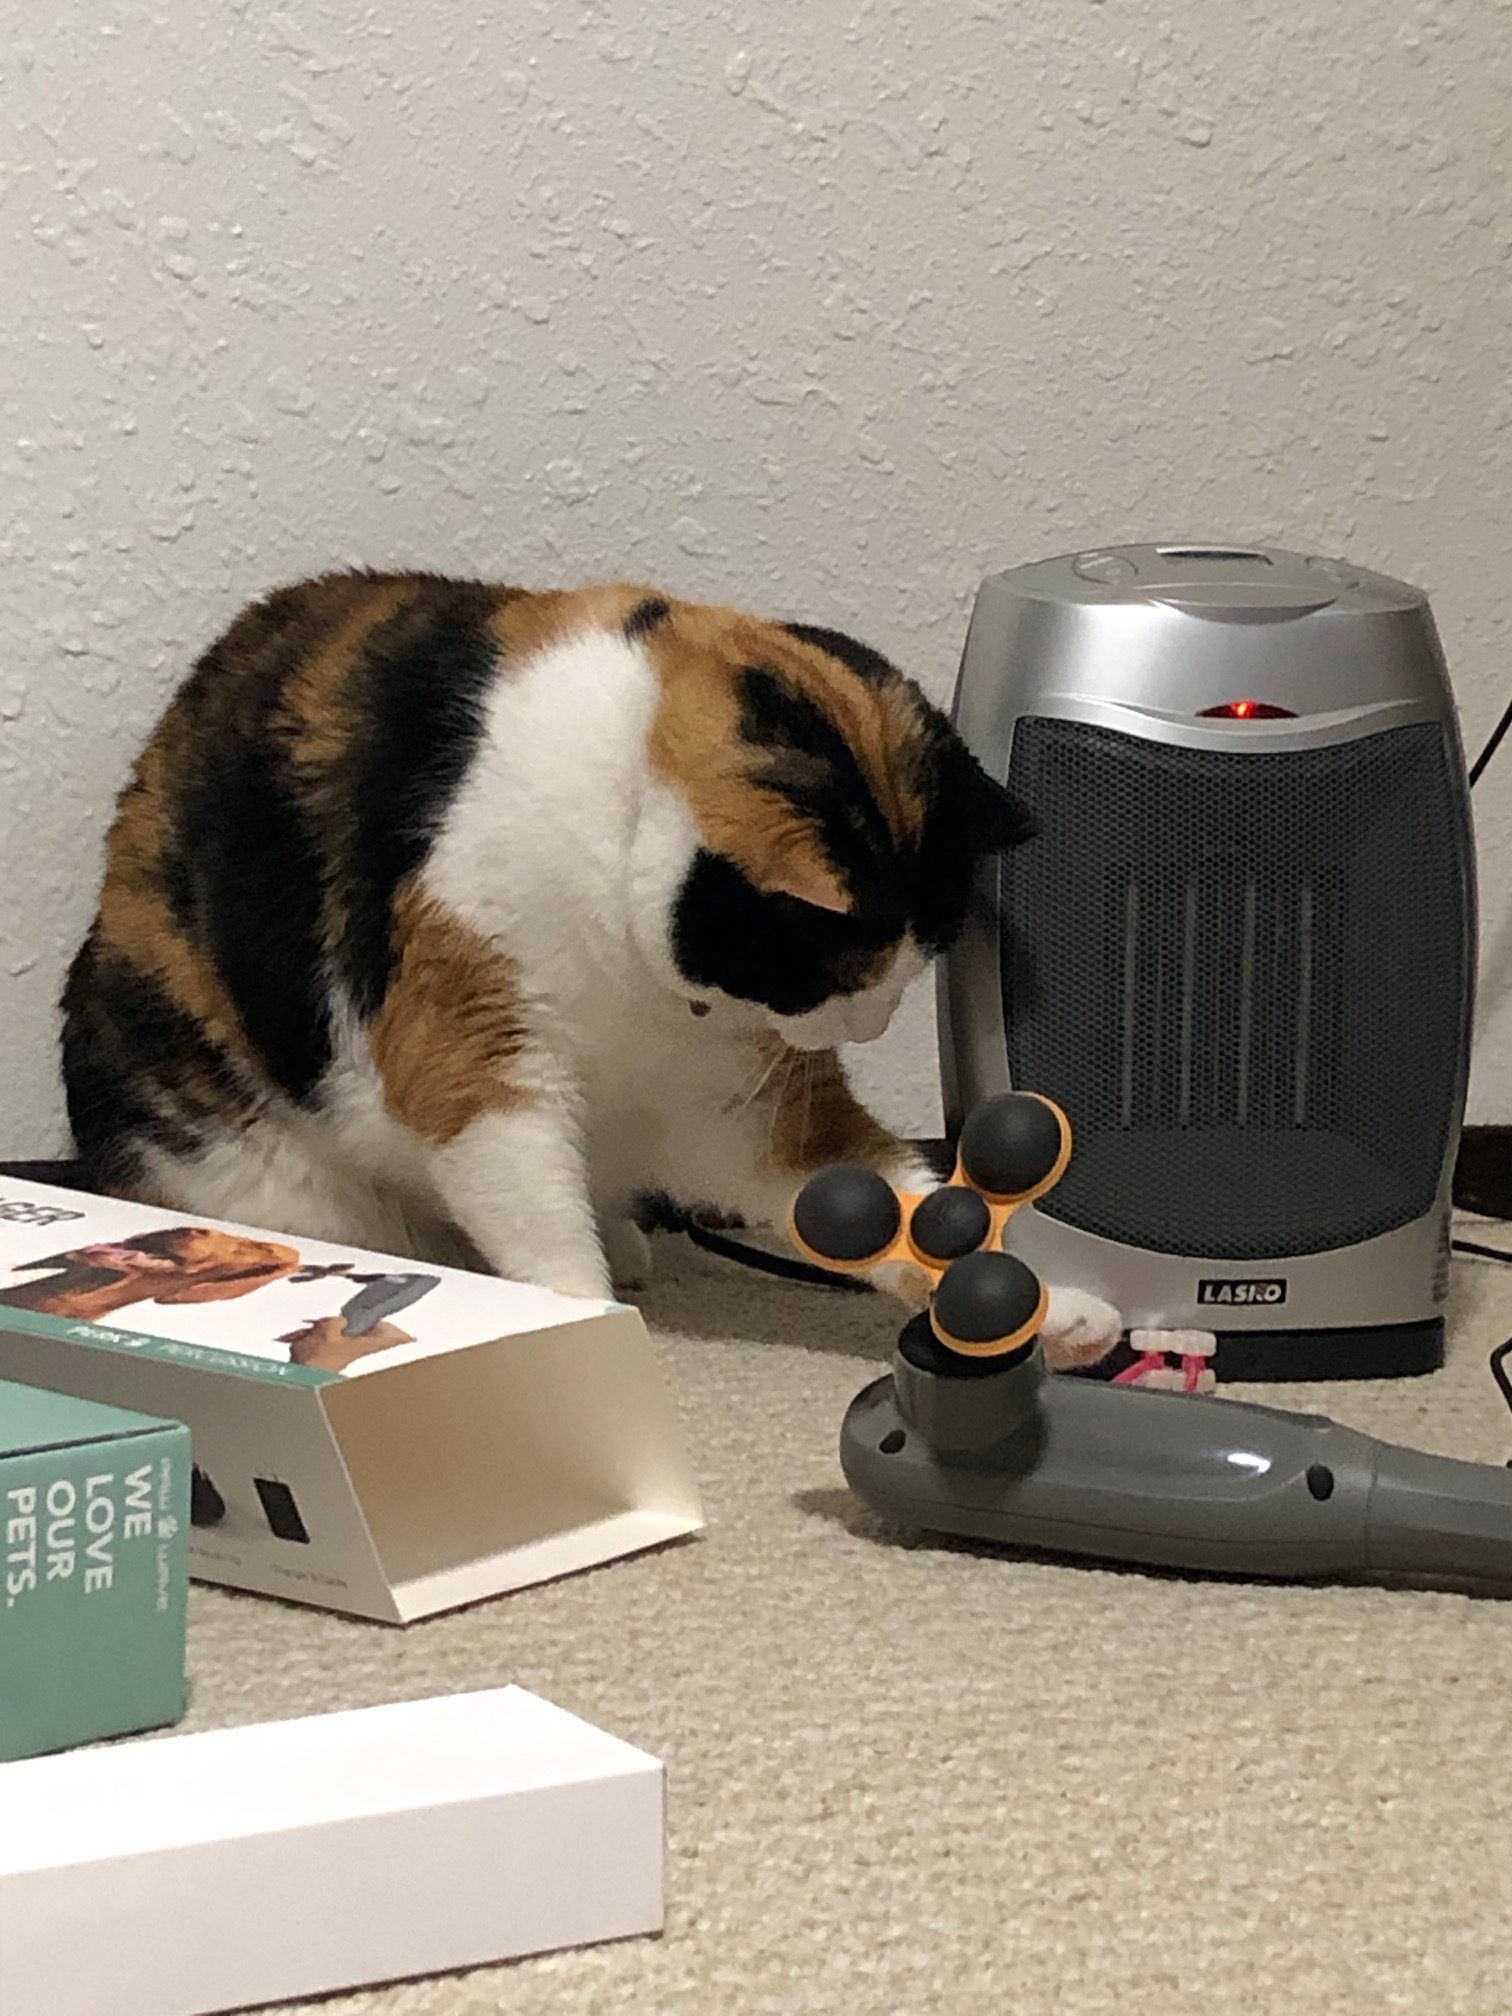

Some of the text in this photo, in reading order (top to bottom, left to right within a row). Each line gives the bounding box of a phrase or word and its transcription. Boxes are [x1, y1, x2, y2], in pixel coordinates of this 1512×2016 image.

[6, 1486, 38, 1608] PETS.
[46, 1479, 76, 1581] OUR
[84, 1473, 115, 1594] LOVE
[124, 1464, 153, 1539] WE
